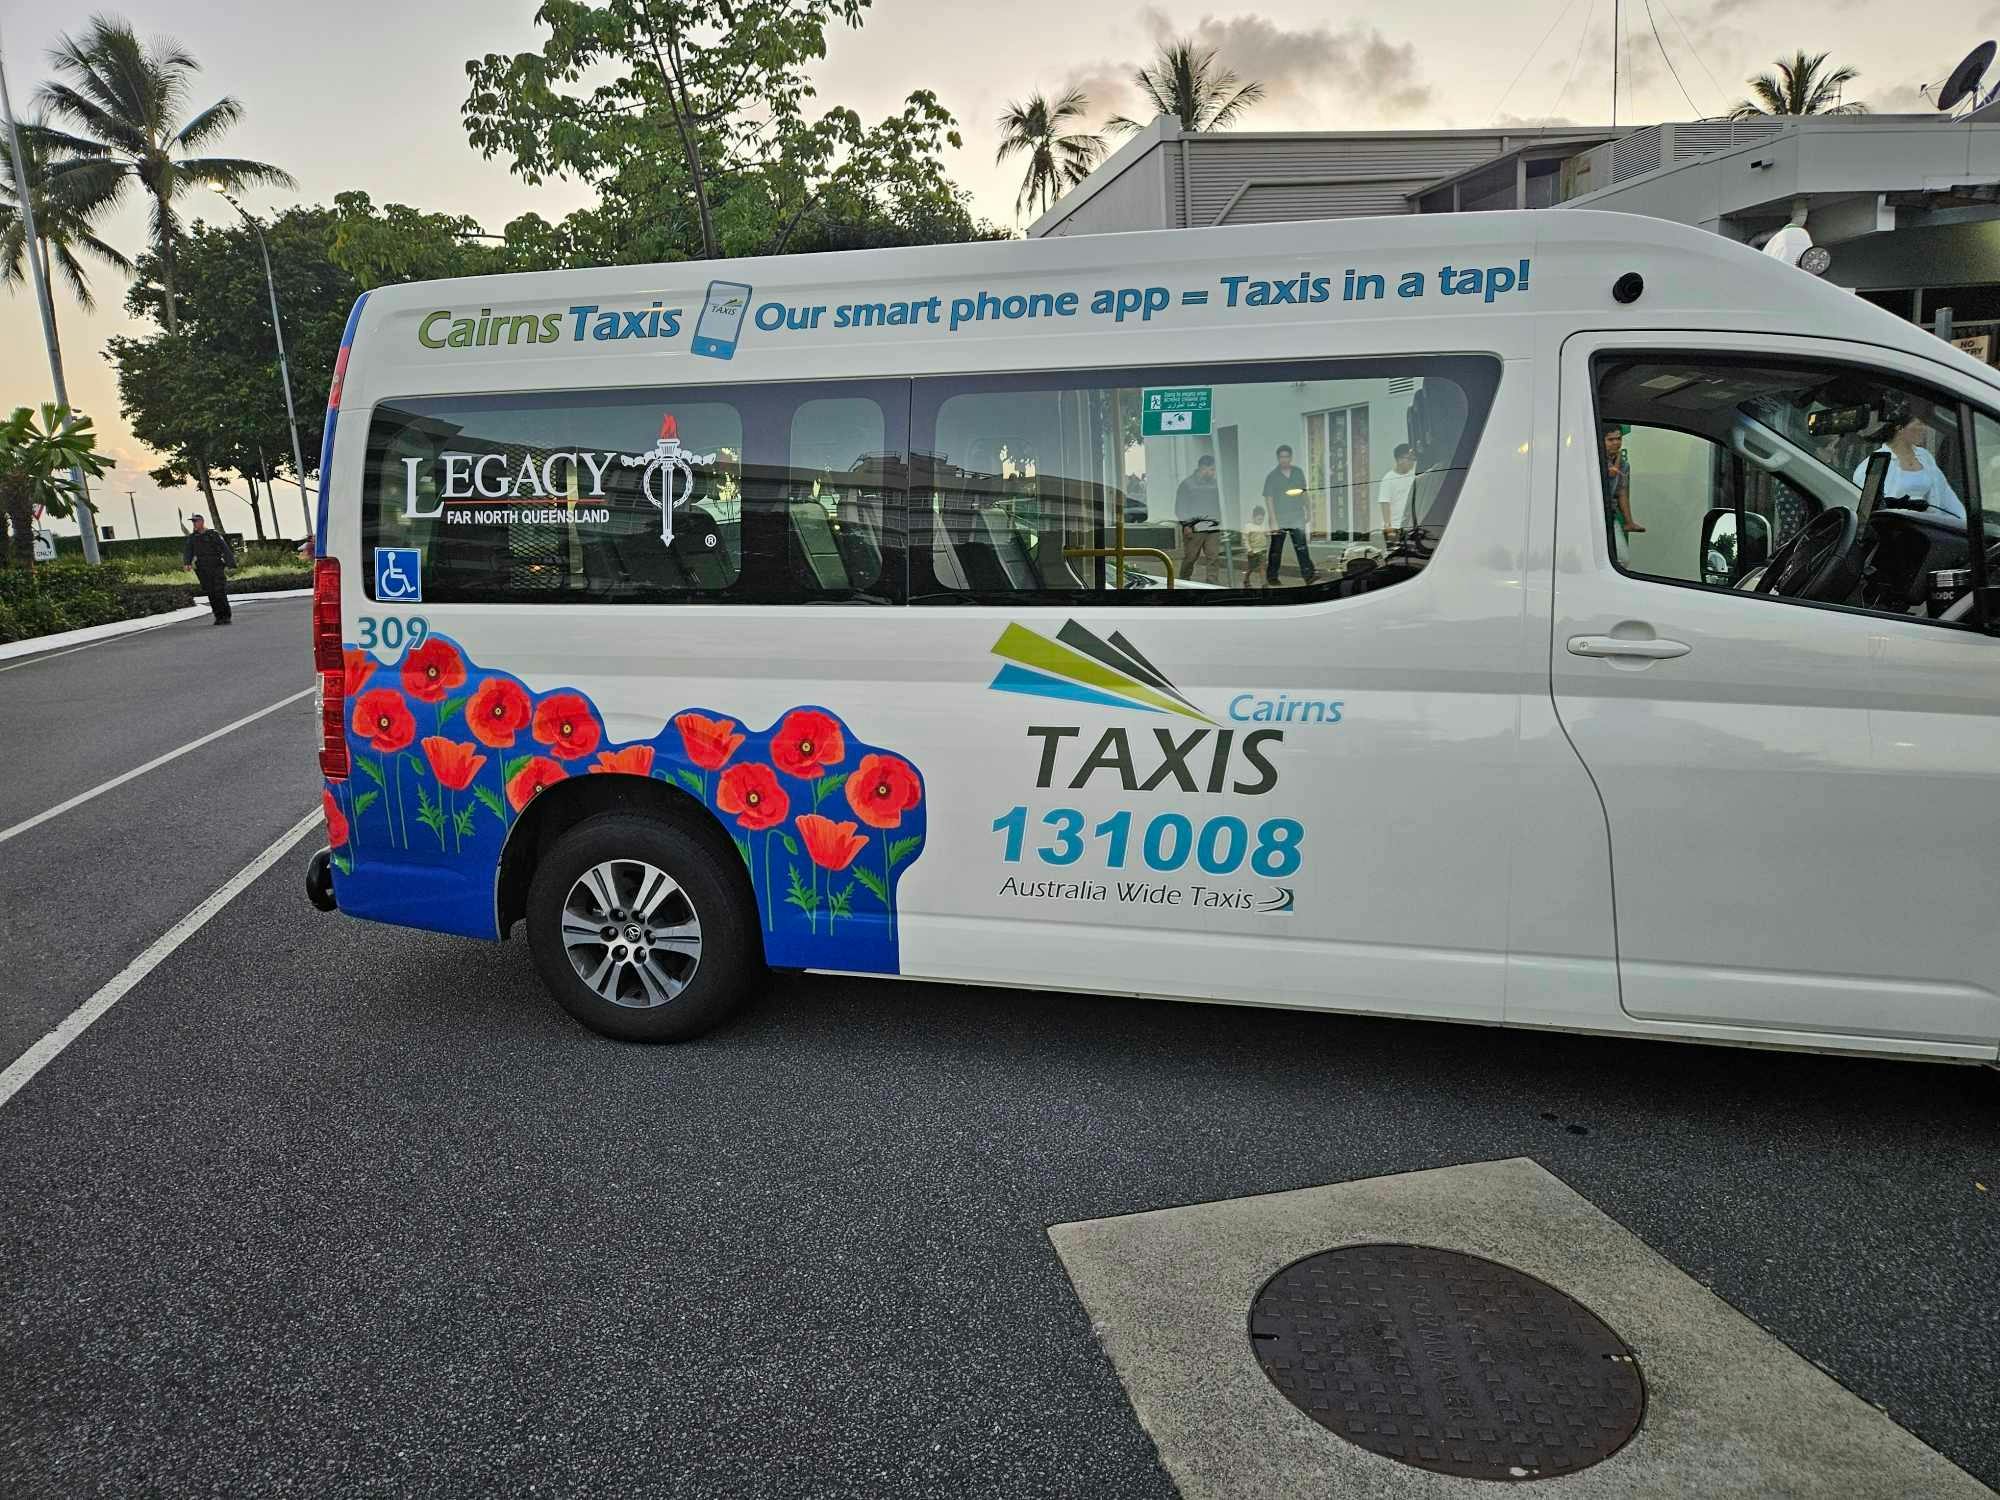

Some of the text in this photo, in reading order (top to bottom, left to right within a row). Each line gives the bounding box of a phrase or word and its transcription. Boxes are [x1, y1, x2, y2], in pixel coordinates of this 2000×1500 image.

[711, 305, 737, 316] TAXIS
[754, 302, 827, 331] Our
[833, 295, 942, 328] smart
[949, 291, 1079, 331] phone
[1090, 287, 1170, 322] app
[1220, 272, 1331, 307] Taxis
[1343, 269, 1385, 301] in
[1397, 271, 1425, 298] a
[1438, 259, 1530, 303] tap!
[418, 301, 682, 349] Cairns Taxis
[1960, 340, 1975, 348] NO
[401, 452, 617, 519] LEGACY
[447, 509, 610, 525] FAR NORTH QUEENSLAND
[358, 616, 429, 649] 309
[1228, 694, 1345, 723] Cairns
[1026, 726, 1285, 796] TAXIS
[991, 805, 1306, 878] 131008
[999, 876, 1253, 910] Australia Wide Taxis
